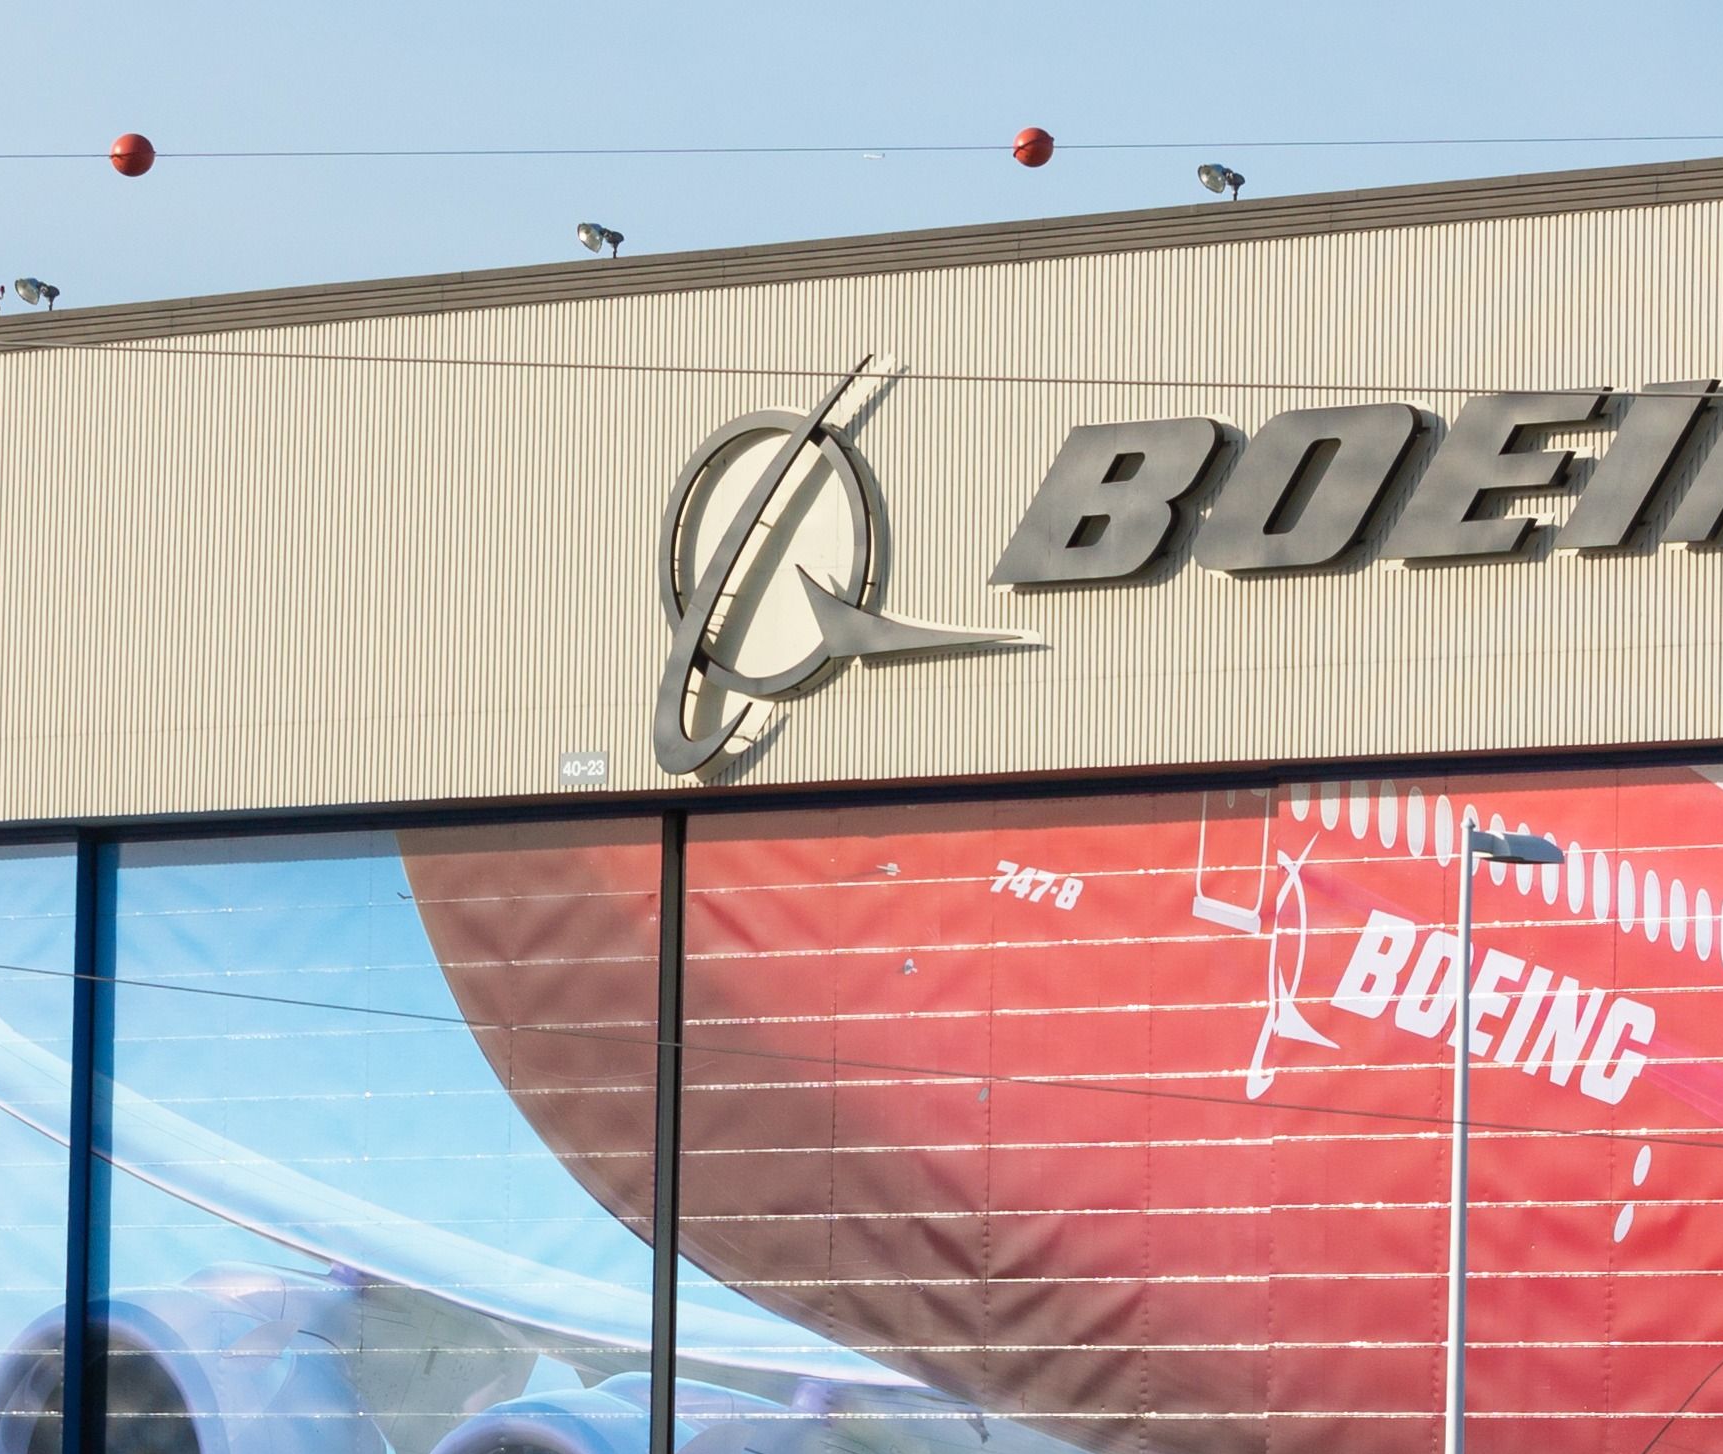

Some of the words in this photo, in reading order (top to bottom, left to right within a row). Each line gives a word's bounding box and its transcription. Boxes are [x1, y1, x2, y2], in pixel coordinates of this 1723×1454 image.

[562, 759, 605, 777] 40-23
[990, 859, 1084, 911] 747-8
[1330, 909, 1656, 1105] BOEING
